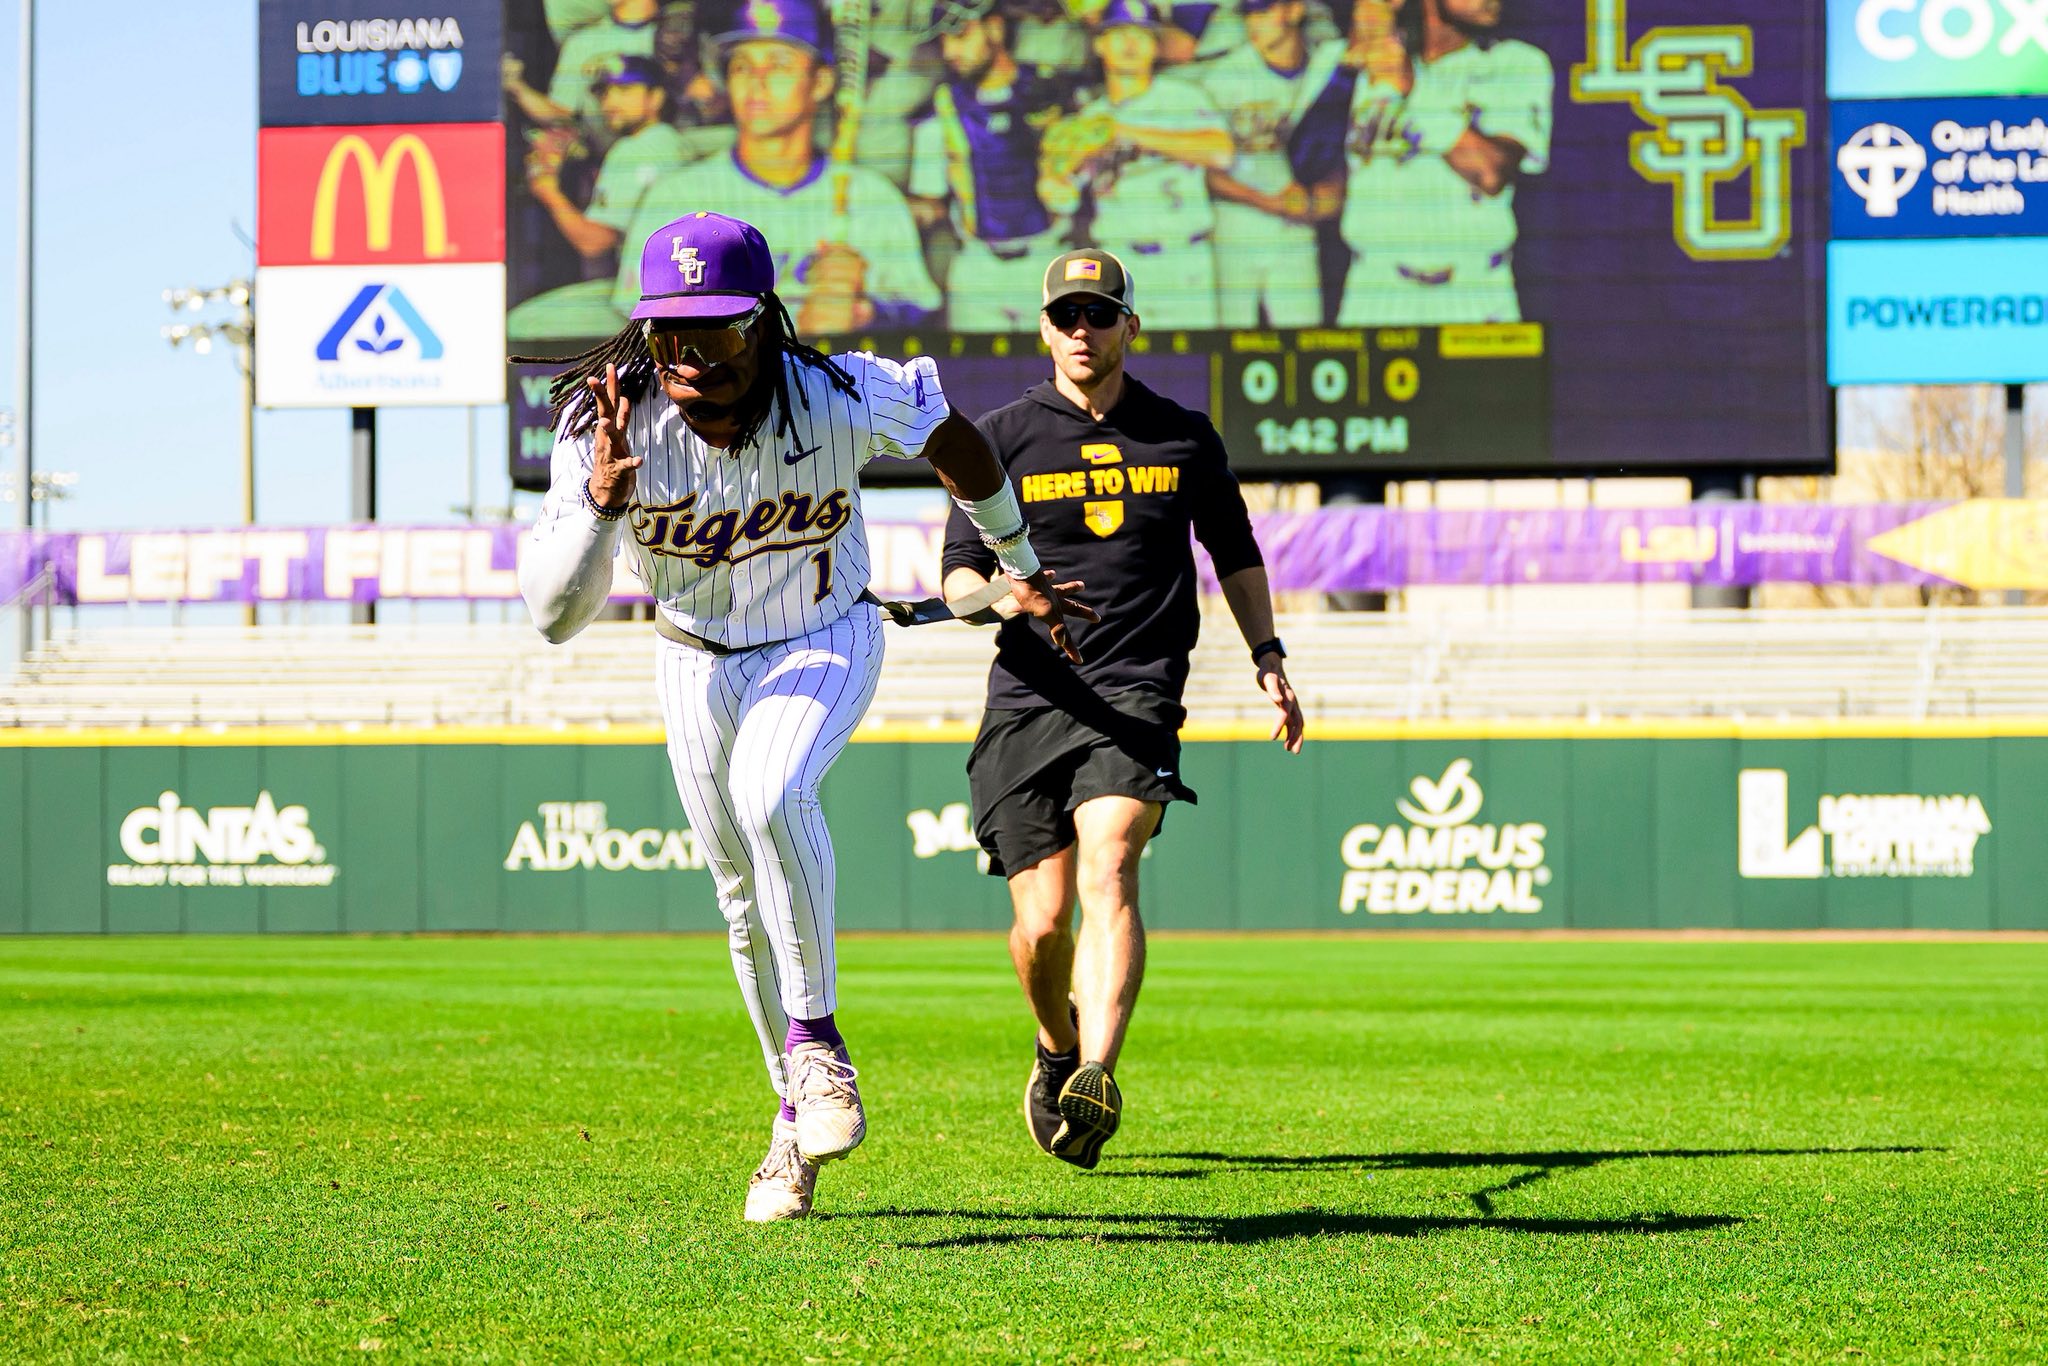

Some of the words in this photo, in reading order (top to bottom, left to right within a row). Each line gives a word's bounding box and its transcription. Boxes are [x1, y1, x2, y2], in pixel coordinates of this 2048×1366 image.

[296, 17, 464, 52] LOUISIANA
[297, 52, 387, 95] BLUE
[1570, 0, 1806, 261] LSU
[1931, 120, 1988, 152] Our
[1932, 151, 1967, 184] of
[1968, 151, 2016, 183] the
[1932, 182, 2024, 216] Health
[670, 236, 706, 285] LSU
[1848, 294, 2048, 328] POWERAD
[1242, 360, 1278, 403] 0
[1311, 359, 1348, 403] 0
[1384, 357, 1419, 401] 0
[1256, 418, 1338, 454] 1:42
[1345, 416, 1409, 453] PM
[1022, 471, 1086, 503] HERE
[1089, 468, 1125, 495] TO
[1127, 466, 1179, 494] WIN
[628, 489, 852, 571] Tigers
[77, 532, 309, 600] LEFT
[323, 530, 531, 599] FIEL
[811, 547, 833, 606] 1
[538, 801, 607, 831] THE
[503, 821, 706, 872] ADVOCAT
[1341, 823, 1547, 869] CAMPUS
[1339, 868, 1543, 915] FEDERAL
